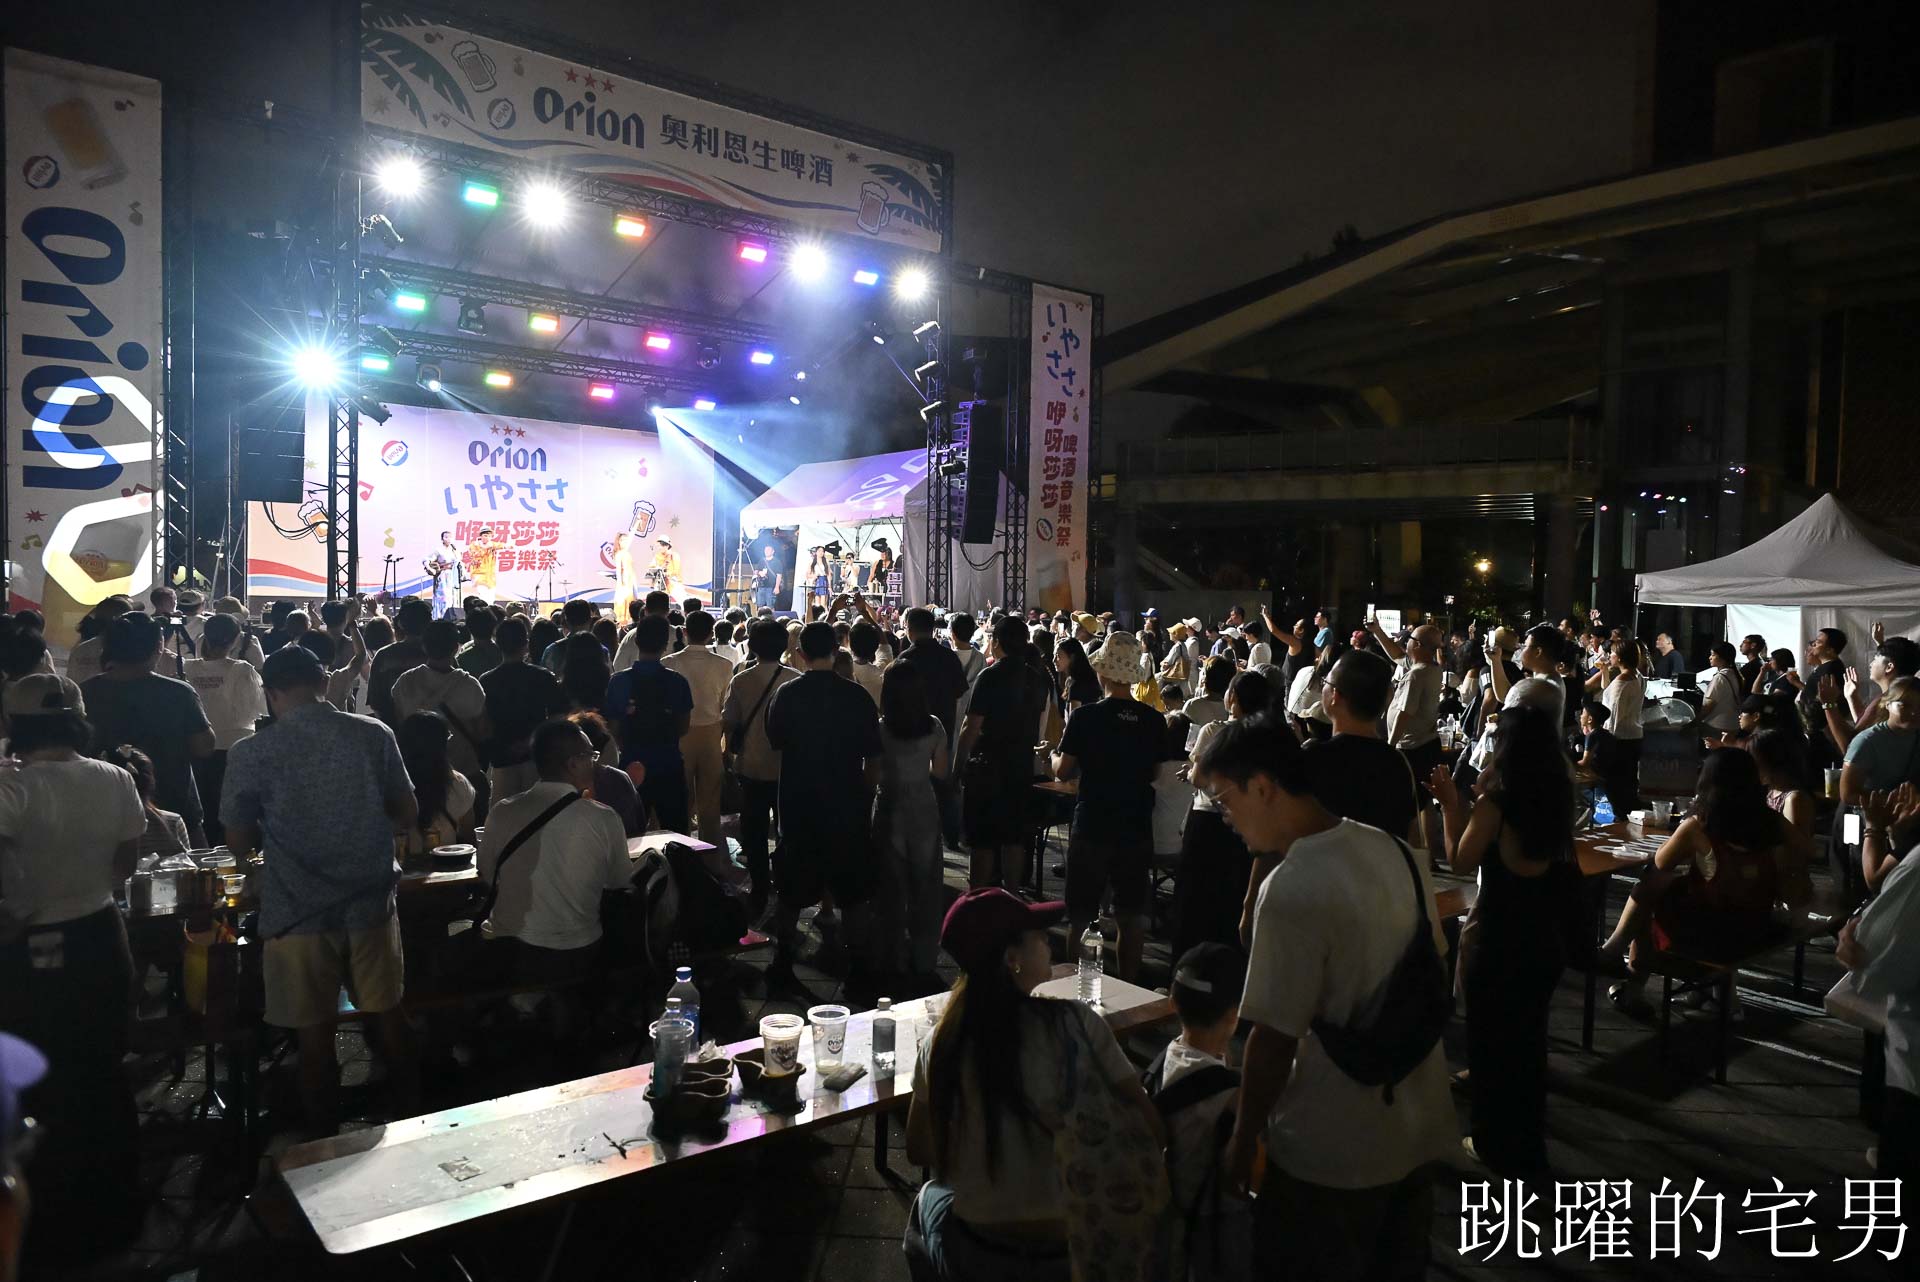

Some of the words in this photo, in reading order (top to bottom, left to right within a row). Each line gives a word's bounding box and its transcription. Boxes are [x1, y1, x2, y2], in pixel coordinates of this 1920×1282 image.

[533, 86, 645, 149] Orion
[21, 206, 149, 490] Orion
[1046, 302, 1080, 397] いやささ
[468, 438, 547, 472] Orion
[444, 474, 569, 516] いやささ
